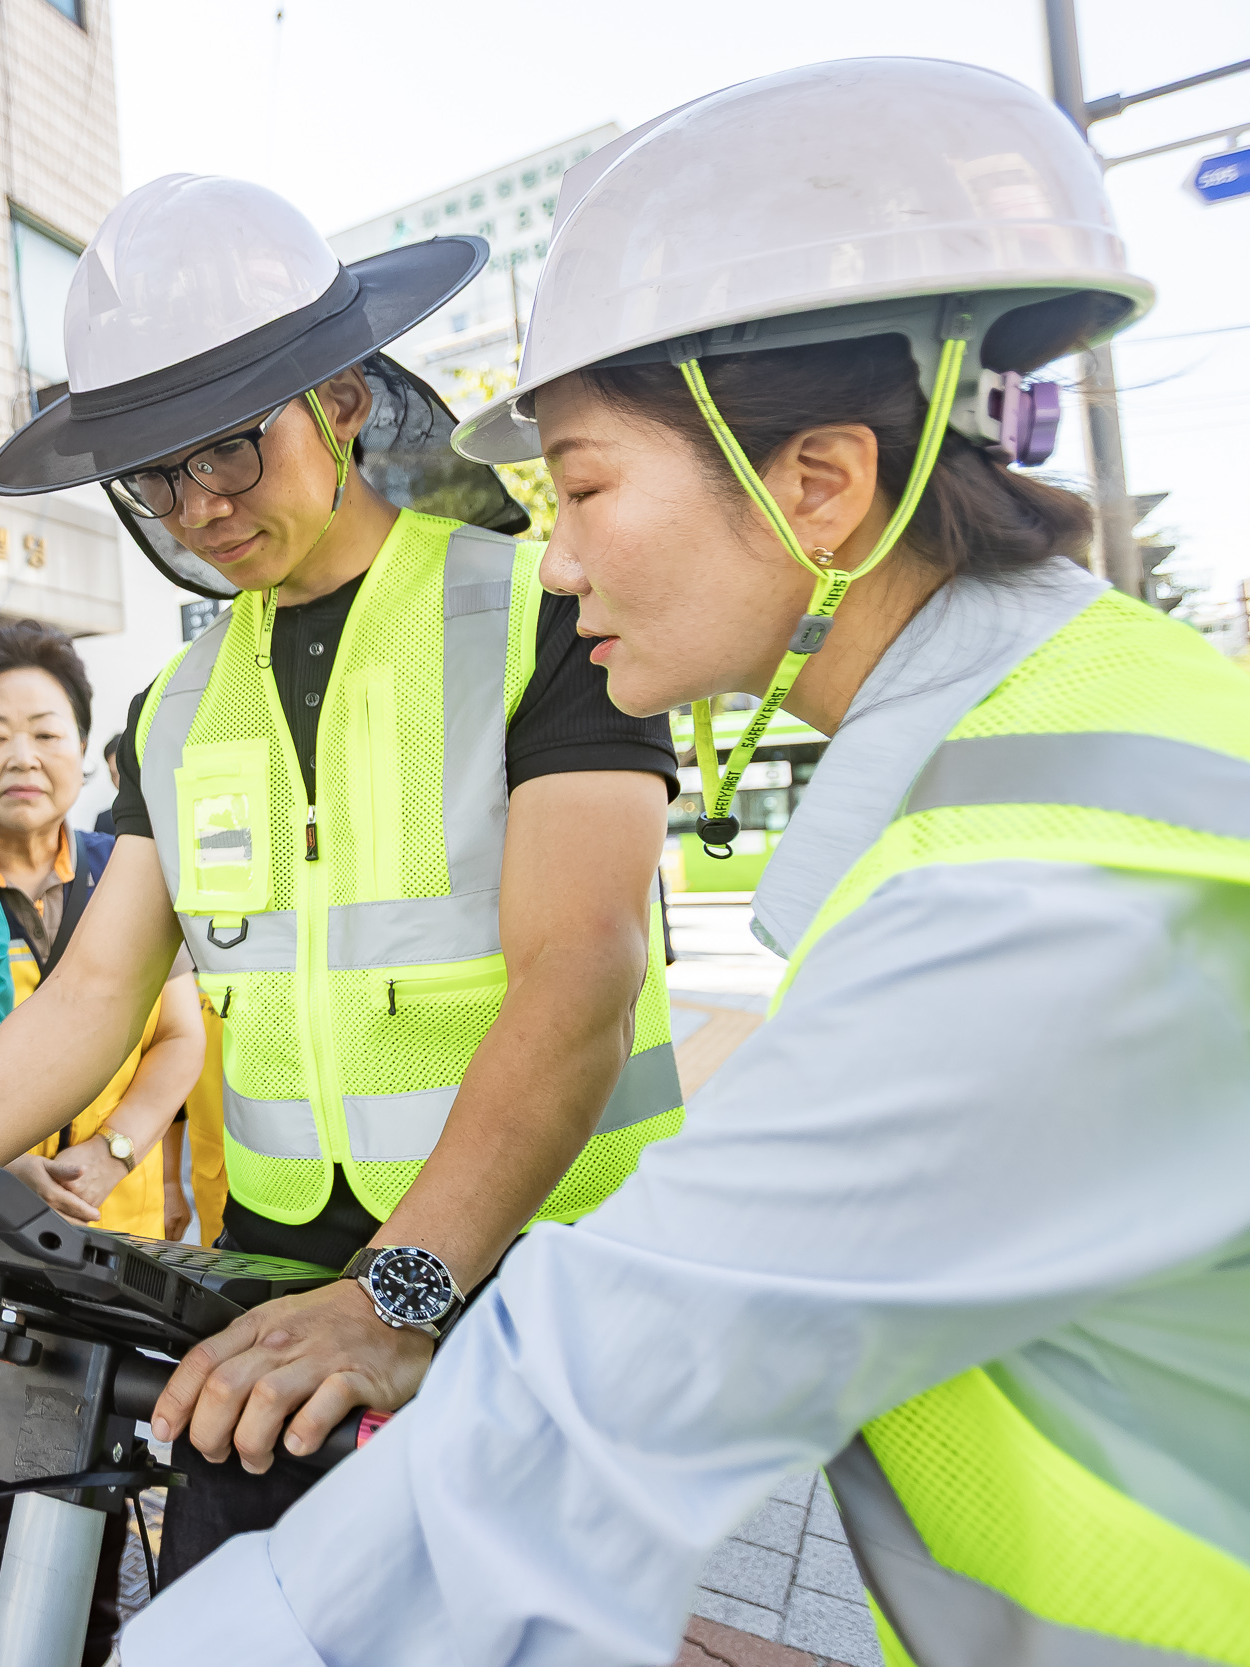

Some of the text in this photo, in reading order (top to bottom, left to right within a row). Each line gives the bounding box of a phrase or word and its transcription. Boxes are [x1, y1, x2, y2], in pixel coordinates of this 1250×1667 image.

[741, 686, 788, 749] SAFETY FIRST
[712, 791, 731, 819] AFETY
